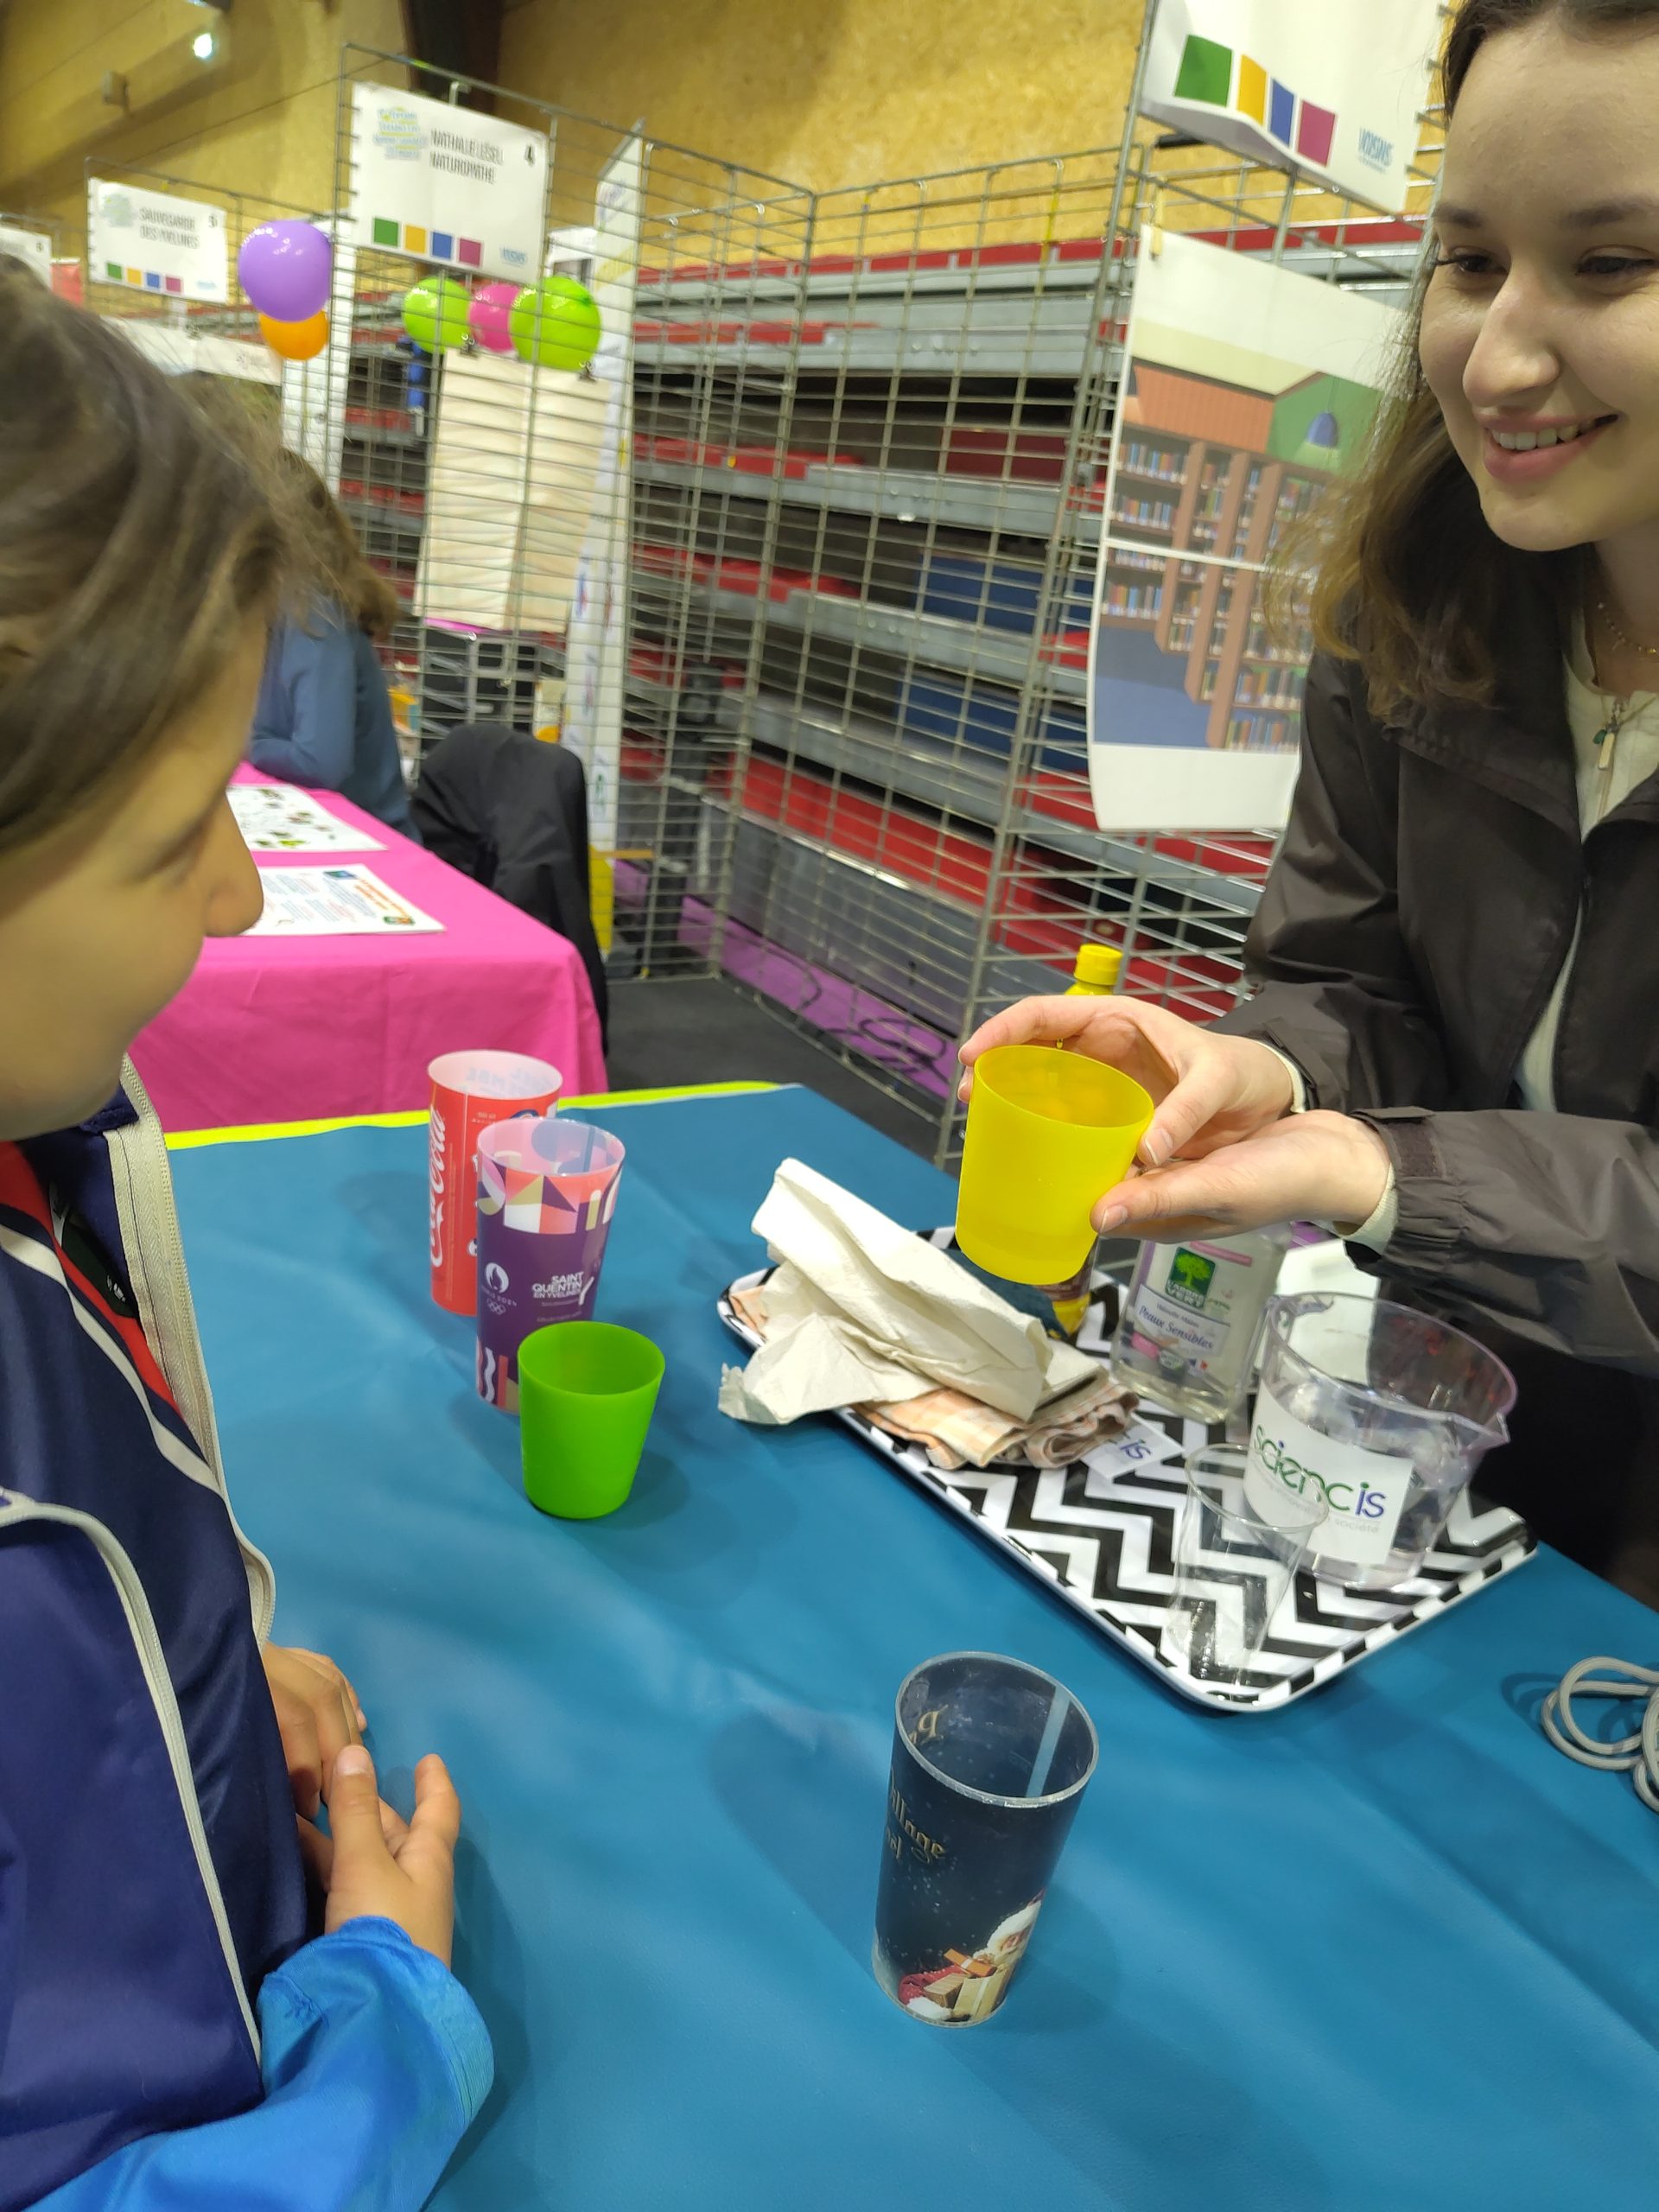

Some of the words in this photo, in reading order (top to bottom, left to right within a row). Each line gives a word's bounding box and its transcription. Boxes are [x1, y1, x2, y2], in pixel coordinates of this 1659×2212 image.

[551, 1271, 584, 1284] SAINT
[531, 1281, 582, 1294] QUENTIN
[1139, 1306, 1165, 1328] Peaux
[1165, 1321, 1214, 1349] Sensibles
